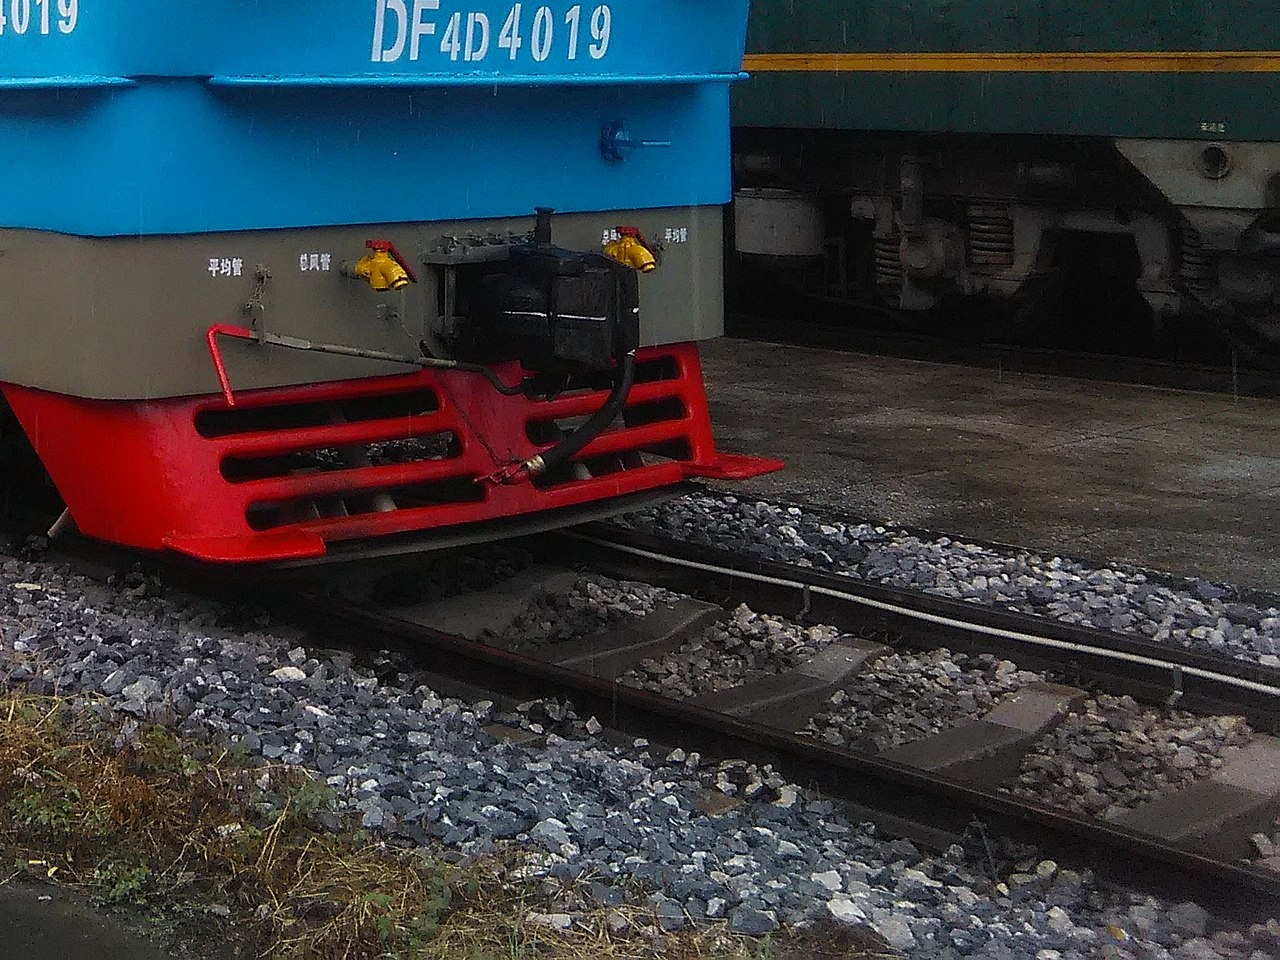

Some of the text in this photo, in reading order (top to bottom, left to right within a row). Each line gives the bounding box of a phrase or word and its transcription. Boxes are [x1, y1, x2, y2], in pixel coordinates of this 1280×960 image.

[208, 257, 243, 277] 平均管
[299, 253, 331, 272] 总风管
